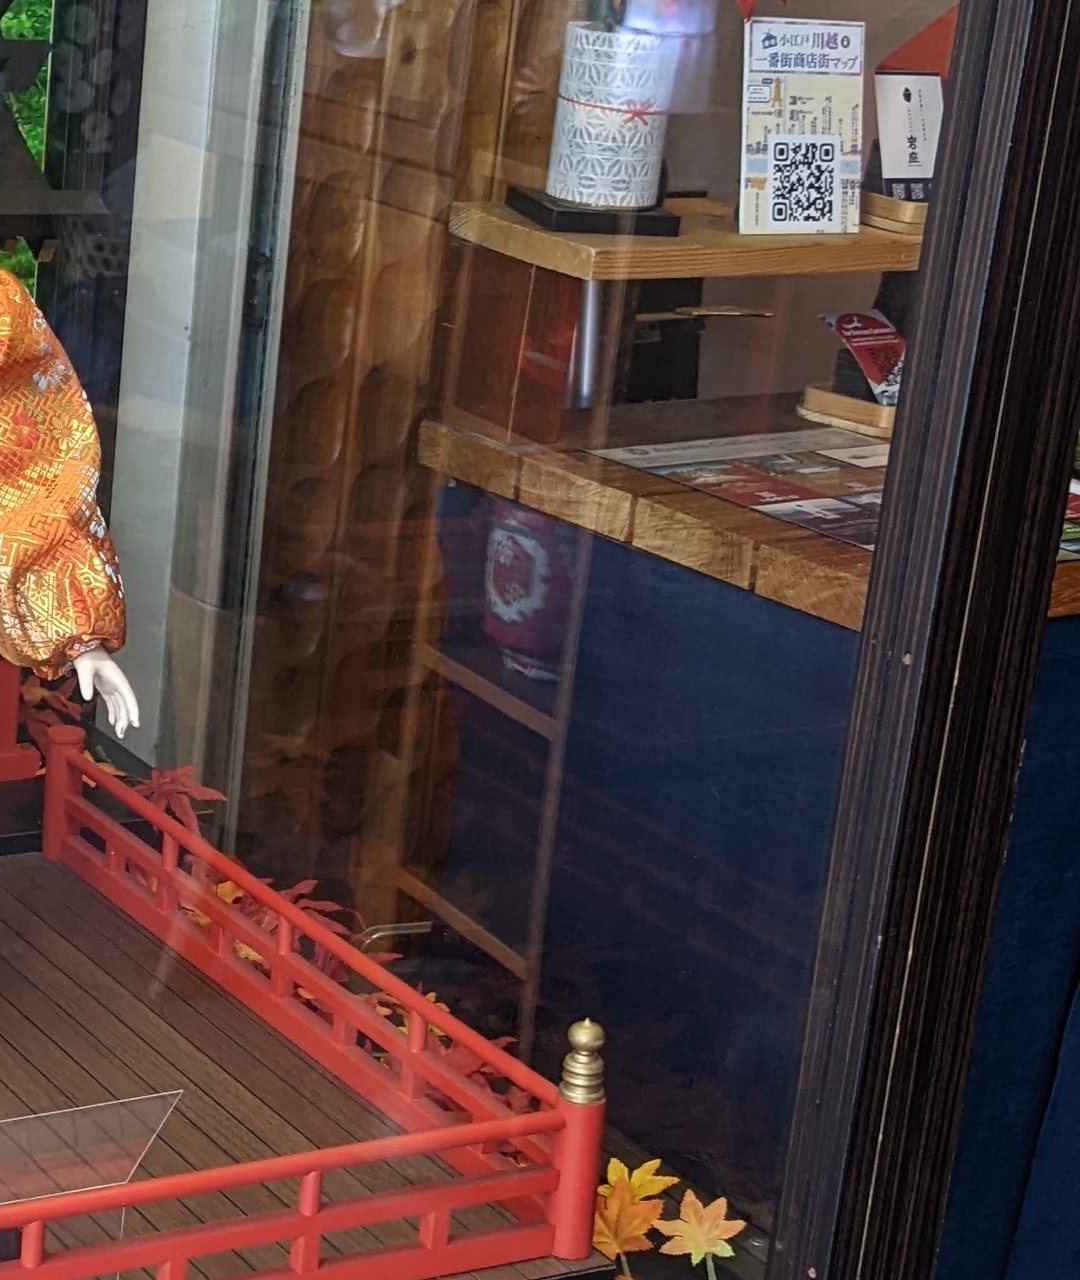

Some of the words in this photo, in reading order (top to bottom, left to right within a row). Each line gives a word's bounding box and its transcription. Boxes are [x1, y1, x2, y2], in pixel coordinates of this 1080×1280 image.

[754, 52, 858, 70] 一番街商店街マップ
